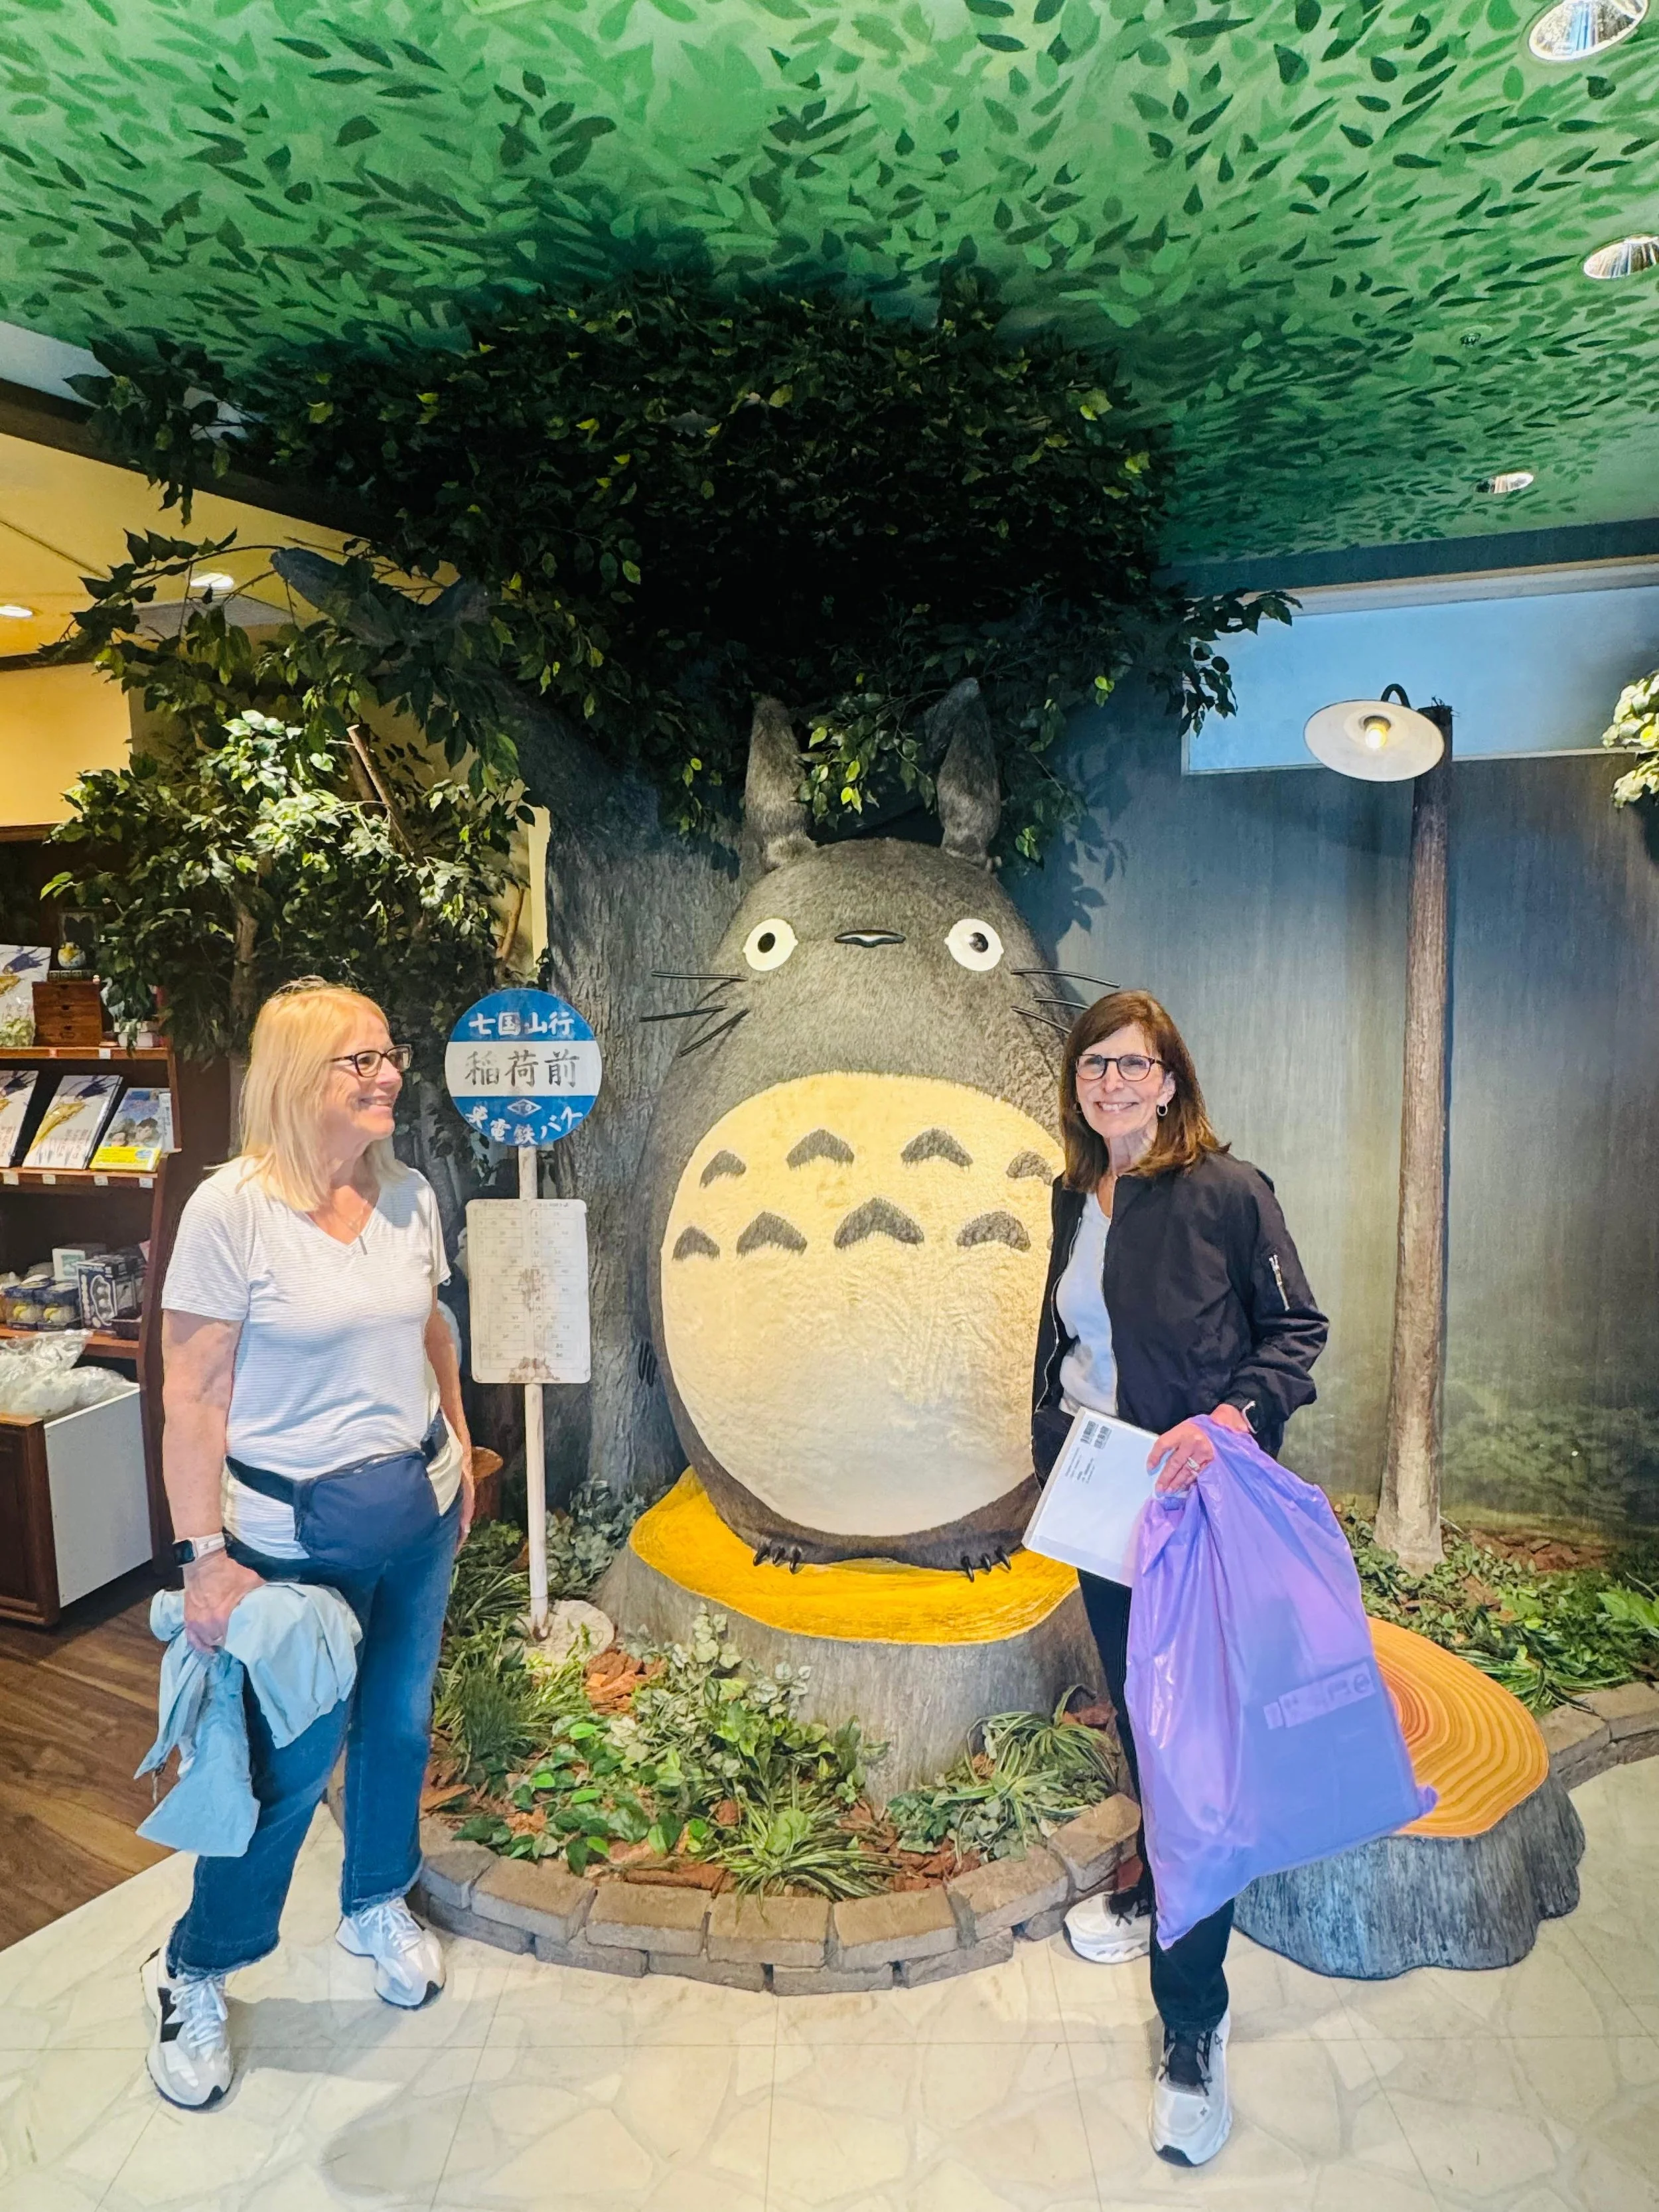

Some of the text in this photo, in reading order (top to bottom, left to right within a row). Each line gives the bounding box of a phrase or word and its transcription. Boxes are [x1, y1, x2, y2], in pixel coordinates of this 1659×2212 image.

[469, 1011, 575, 1036] 七国山行
[465, 1049, 580, 1088] 稲荷前
